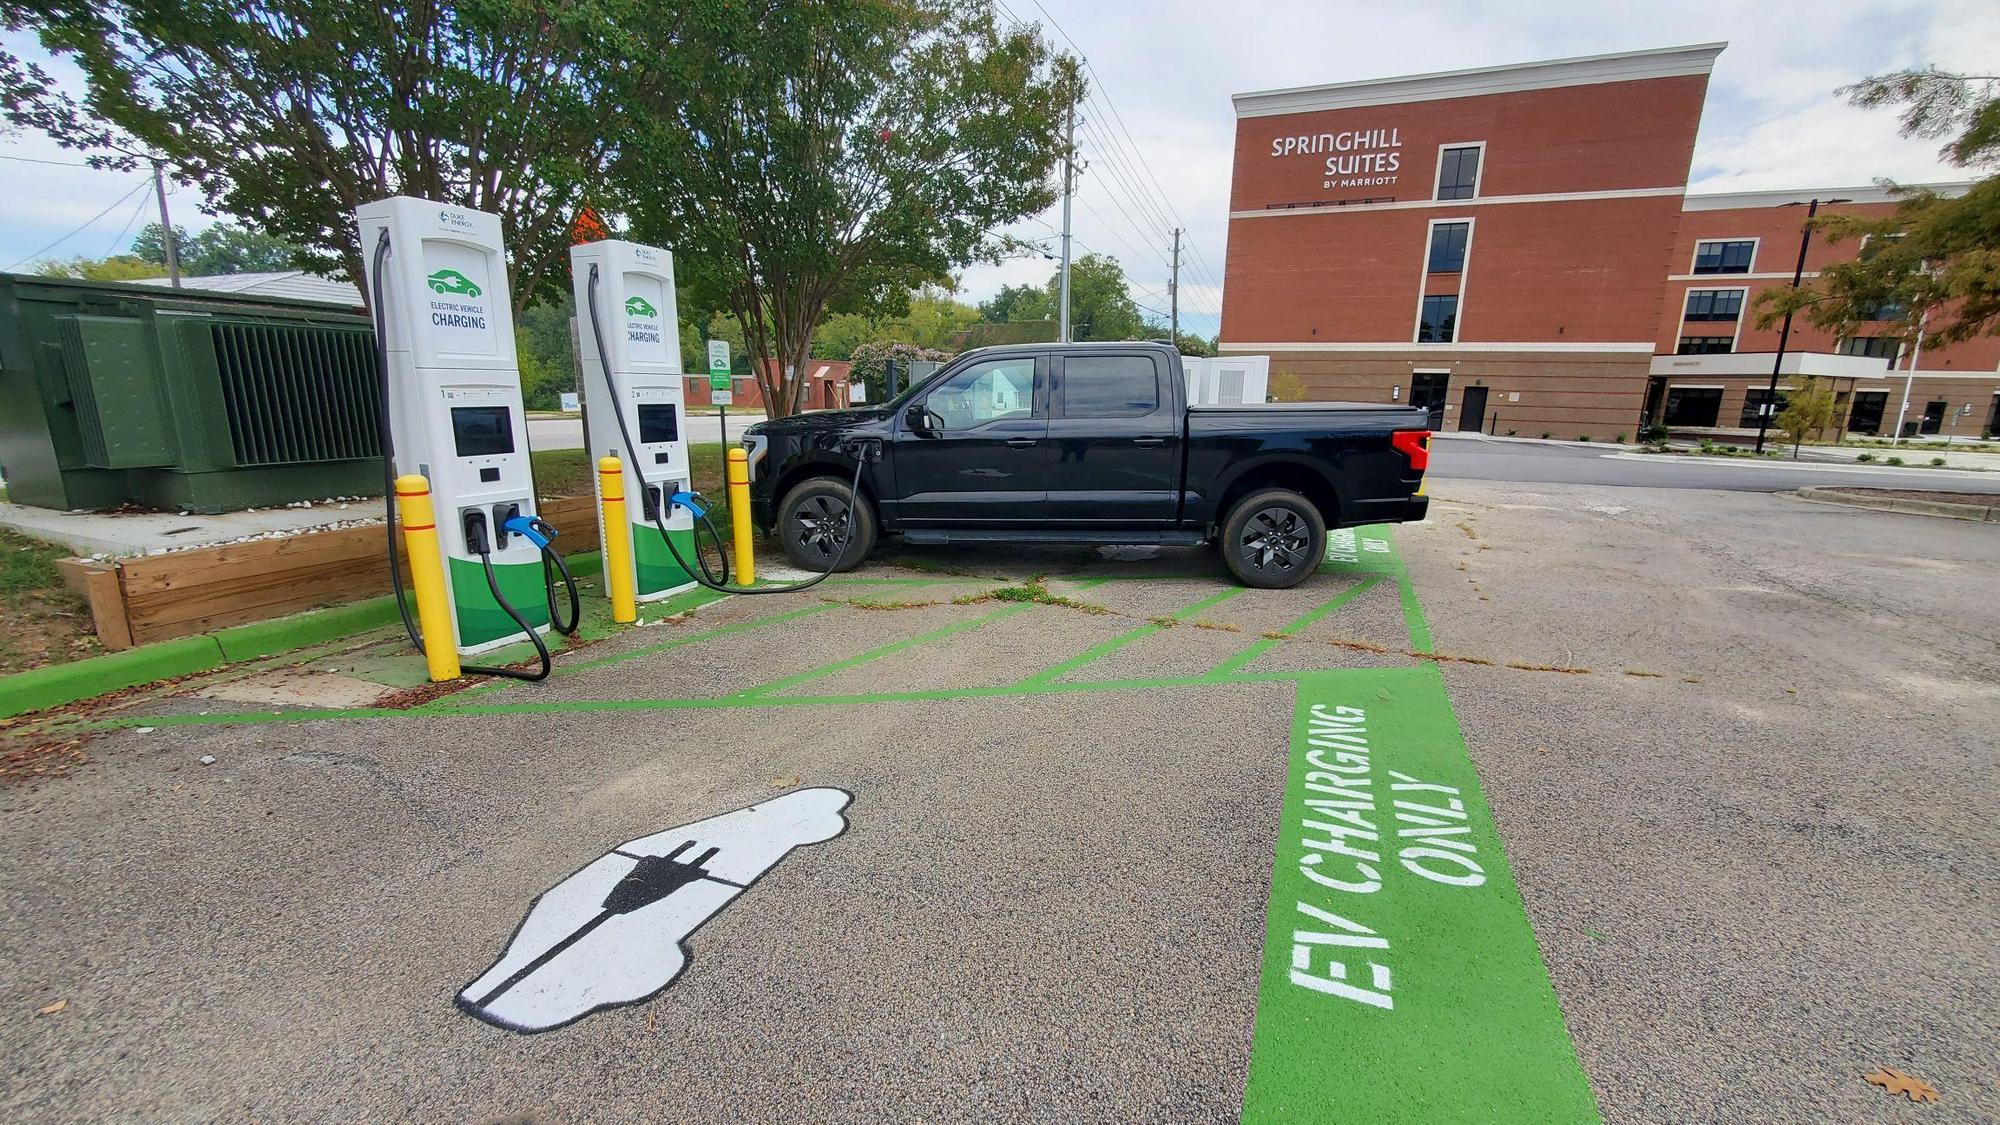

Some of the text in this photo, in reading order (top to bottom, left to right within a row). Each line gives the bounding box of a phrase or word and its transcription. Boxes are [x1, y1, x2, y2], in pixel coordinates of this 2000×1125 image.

[1271, 128, 1402, 157] SPRINGHILL
[1324, 152, 1400, 176] SUITES
[1323, 176, 1398, 189] BY MARRIOTT
[450, 212, 465, 220] DUKE
[431, 301, 484, 314] ELECTRIC VEHICLE
[432, 312, 486, 329] CHARGING
[1388, 769, 1487, 887] ONLY
[1290, 704, 1394, 1010] EV CHARGING
